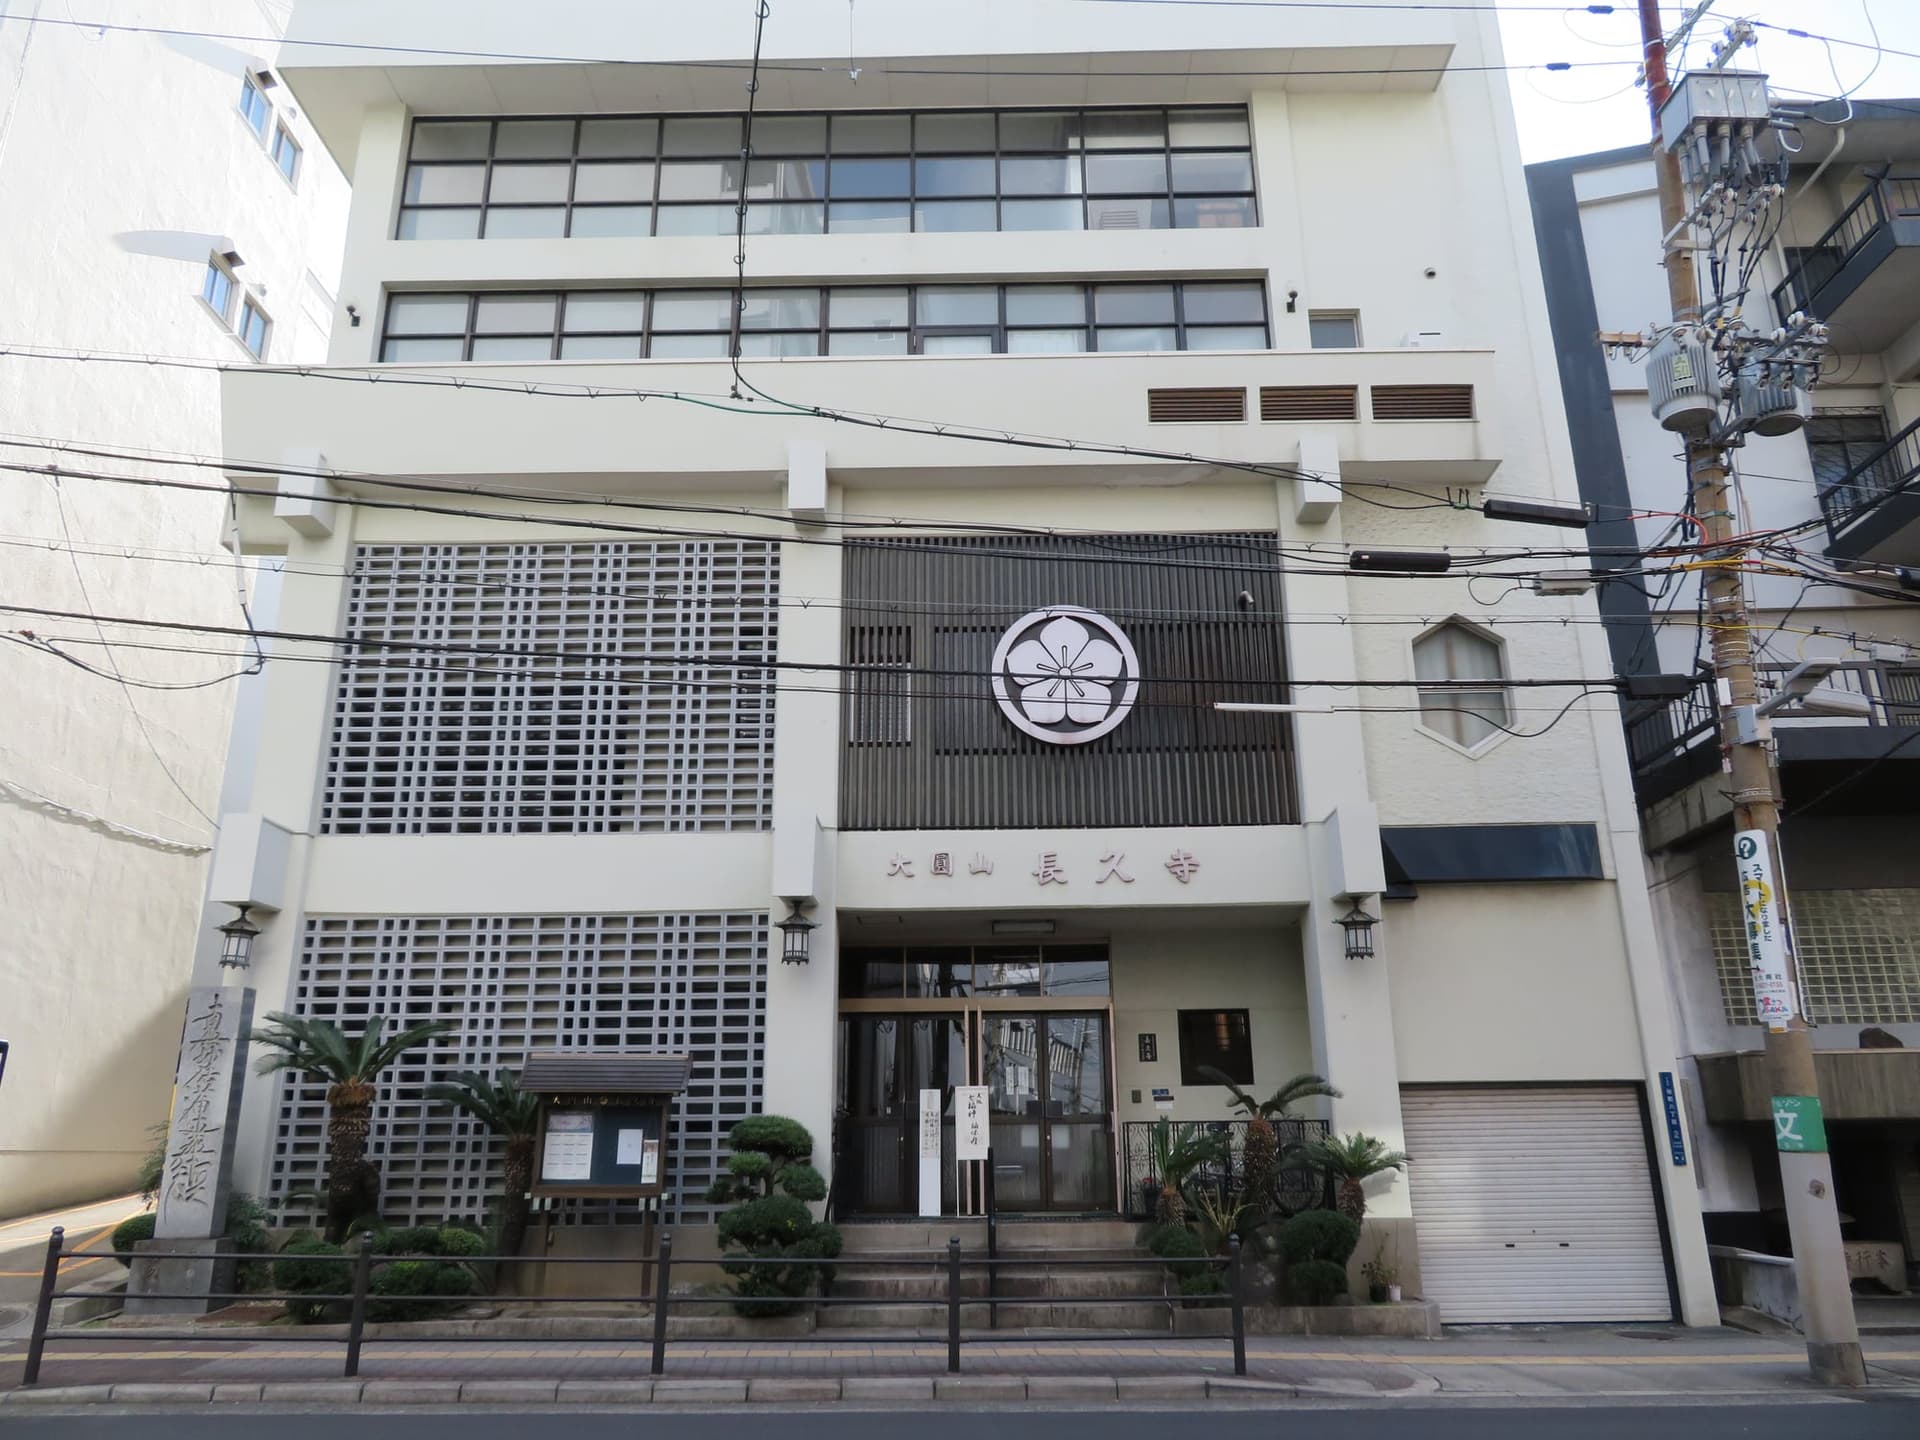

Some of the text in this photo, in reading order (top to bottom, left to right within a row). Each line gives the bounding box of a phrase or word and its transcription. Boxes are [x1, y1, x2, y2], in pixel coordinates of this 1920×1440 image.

[1032, 849, 1201, 886] 長久寺
[1774, 1109, 1803, 1141] 文
